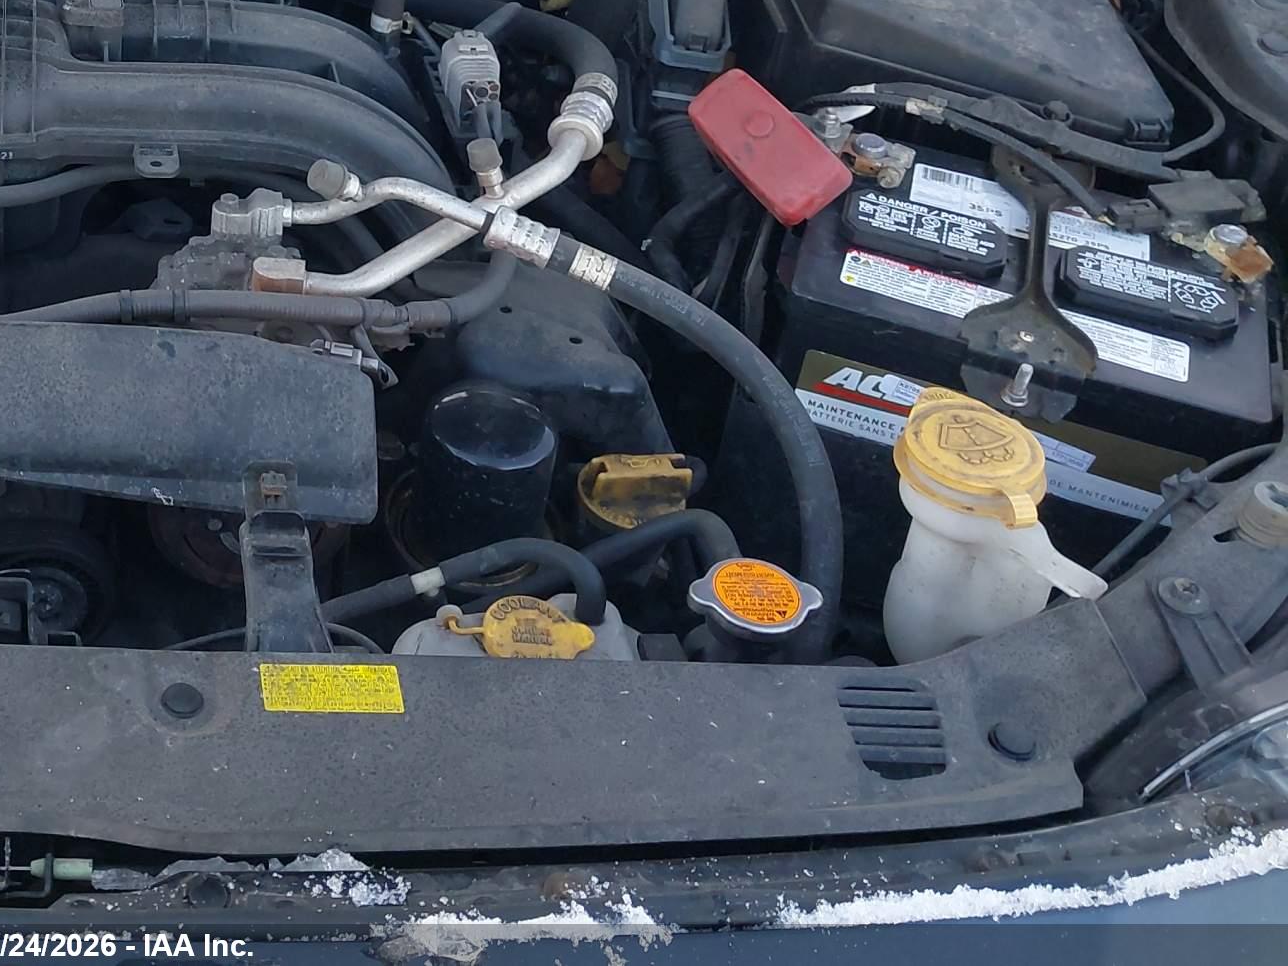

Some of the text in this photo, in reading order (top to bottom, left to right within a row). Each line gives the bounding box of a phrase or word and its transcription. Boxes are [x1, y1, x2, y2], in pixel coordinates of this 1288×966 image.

[878, 194, 929, 215] DANGER
[940, 210, 987, 230] POISON
[807, 399, 897, 432] MAINTENANCE
[1068, 484, 1156, 514] MANTENIMIEN
